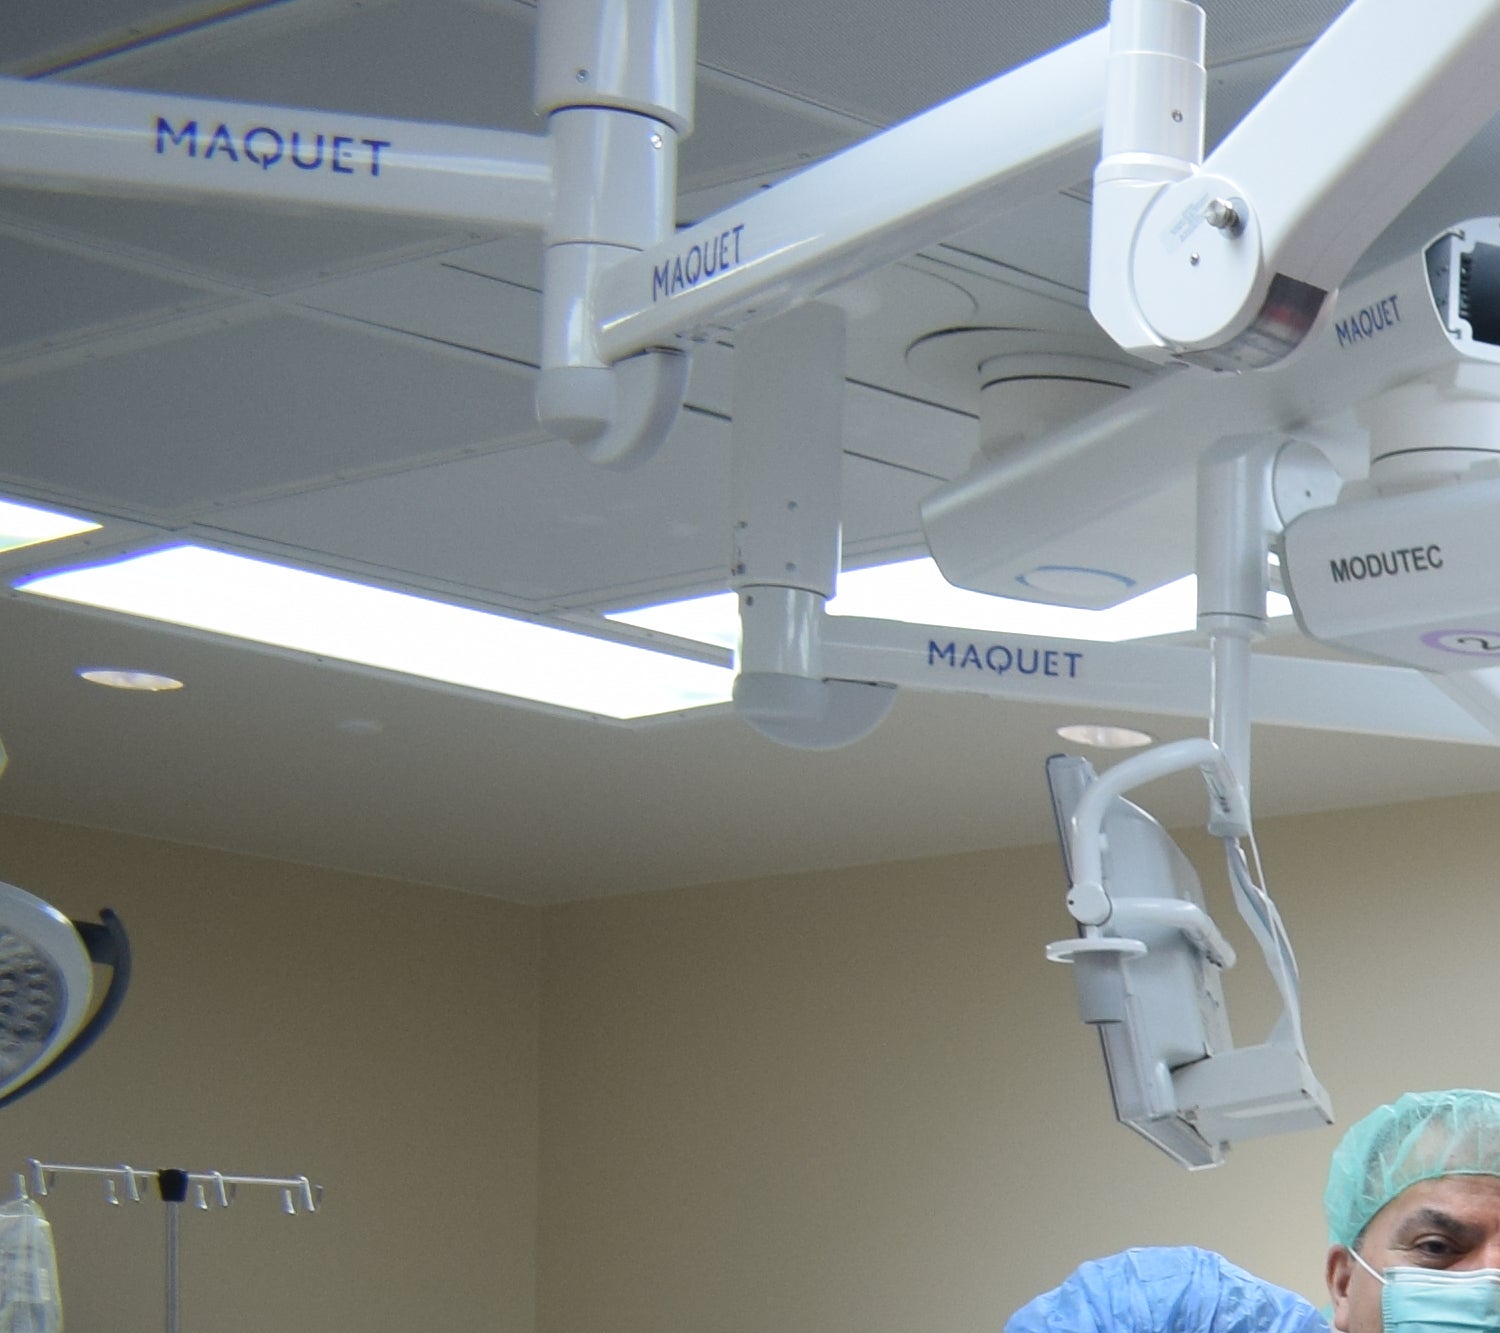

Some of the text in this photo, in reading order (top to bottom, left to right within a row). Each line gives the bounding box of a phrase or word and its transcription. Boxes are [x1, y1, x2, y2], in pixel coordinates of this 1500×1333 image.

[156, 116, 391, 177] MAQUET
[653, 224, 744, 302] MAQUET
[1335, 294, 1400, 348] MAQUET
[1330, 544, 1444, 583] MODUTEC
[928, 639, 1083, 678] MAQUET
